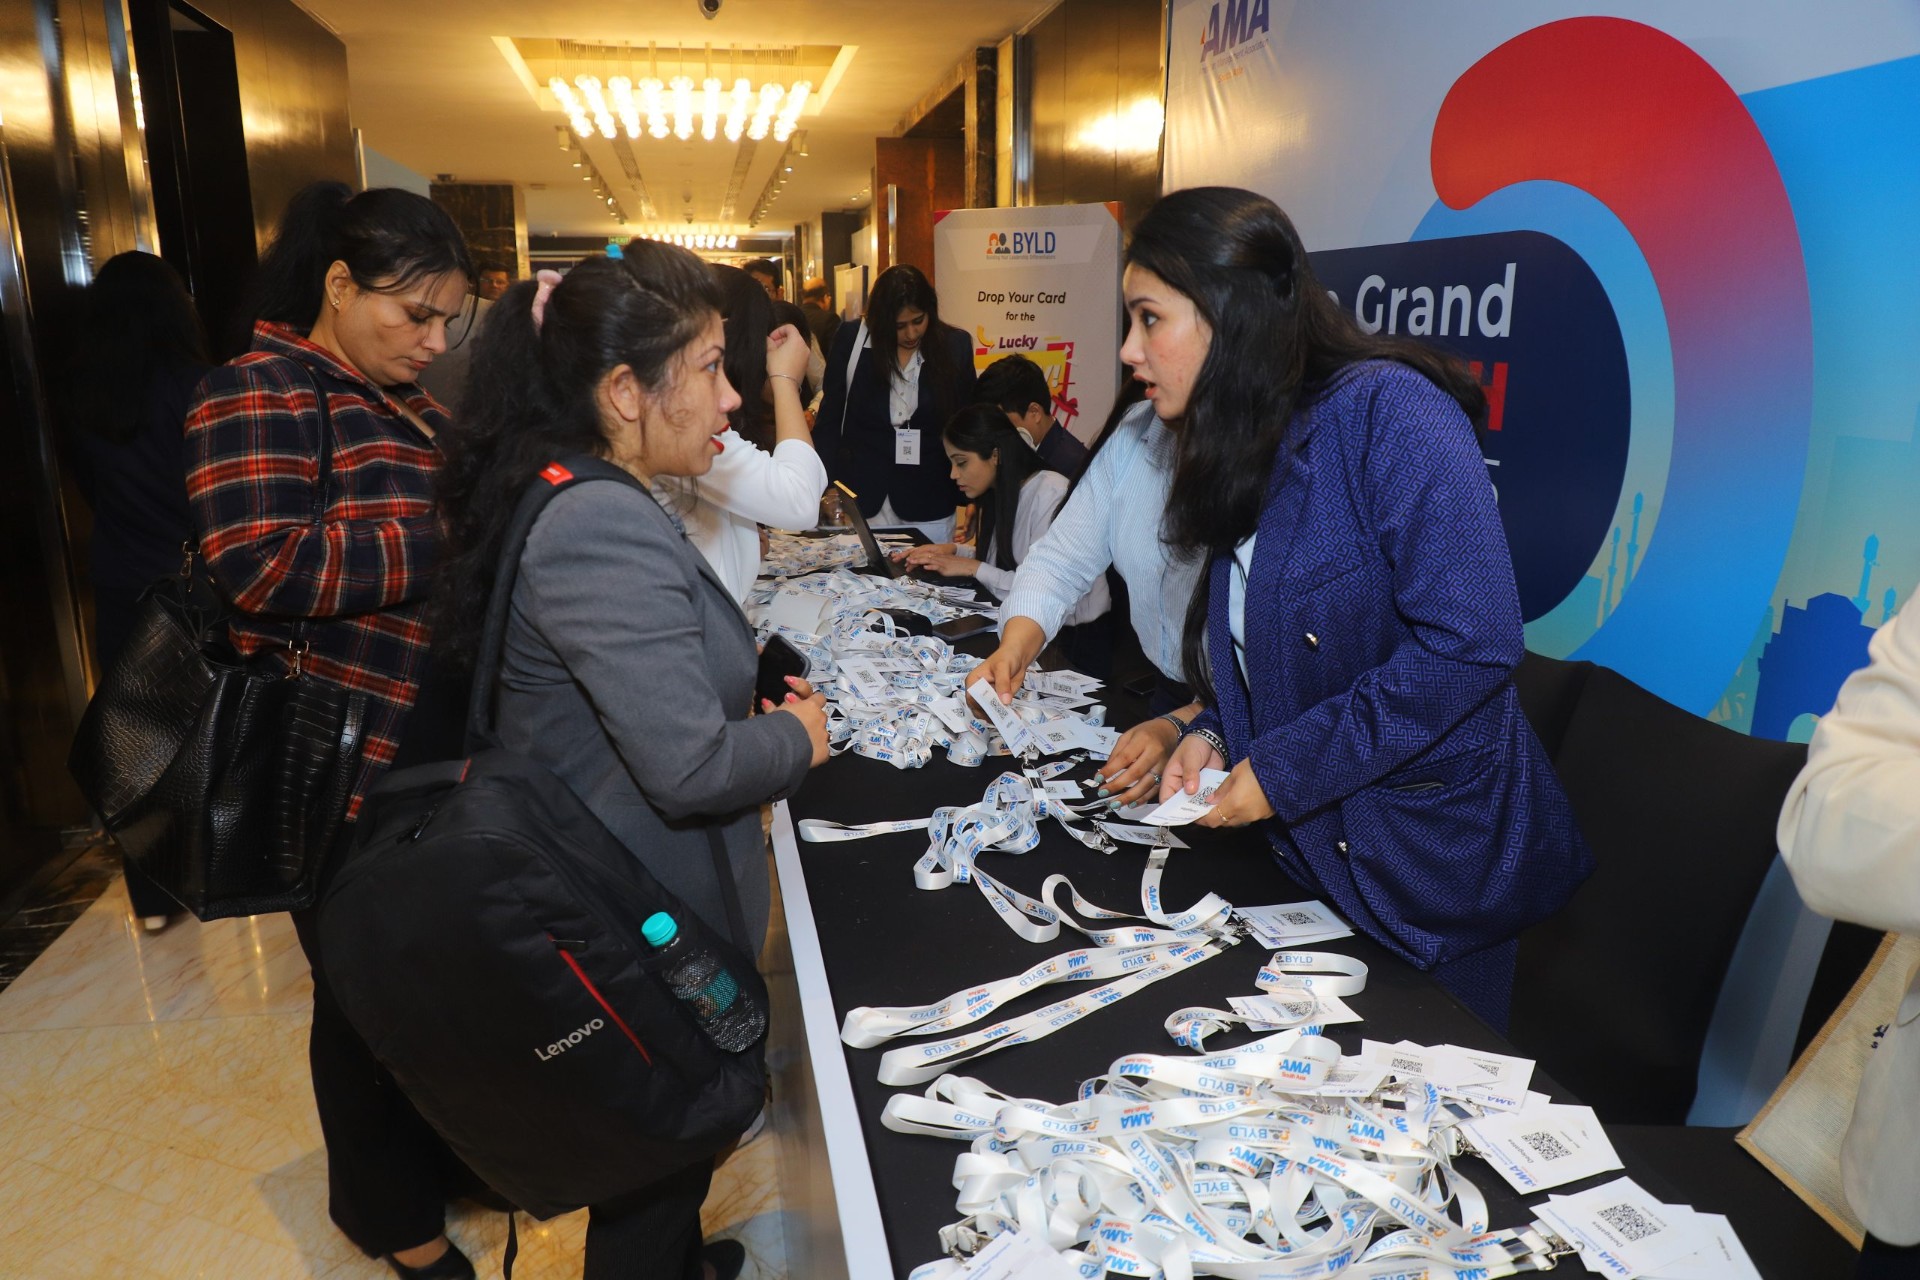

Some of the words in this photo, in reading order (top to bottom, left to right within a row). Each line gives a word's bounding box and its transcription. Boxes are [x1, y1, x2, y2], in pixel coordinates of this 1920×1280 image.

[1200, 0, 1269, 62] AMA
[1013, 231, 1056, 254] BYLD
[977, 291, 1005, 305] Drop
[1008, 291, 1034, 303] Your
[1037, 292, 1067, 304] Card
[1355, 262, 1517, 338] Grand
[1006, 311, 1018, 321] for
[1020, 312, 1036, 321] the
[998, 335, 1039, 350] Lucky
[1149, 885, 1159, 911] AMA
[1038, 908, 1057, 921] BYLD
[1172, 914, 1196, 929] BYLD
[1134, 933, 1155, 942] AMA
[1068, 955, 1088, 968] AMA
[1122, 957, 1143, 968] BYLD
[1182, 951, 1205, 963] AMA
[1020, 969, 1044, 986] BYLD
[1100, 992, 1123, 1004] AMA
[910, 1009, 937, 1019] BYLD
[968, 1000, 994, 1018] AMA
[1186, 1012, 1215, 1020] BYLD
[534, 1017, 604, 1062] Lenovo
[984, 1026, 1010, 1039] AMA
[924, 1044, 952, 1057] BYLD
[1120, 1064, 1155, 1074] AMA
[1280, 1059, 1311, 1075] AMA
[1198, 1077, 1235, 1093] BYLD
[1199, 1102, 1235, 1113] BYLD
[954, 1113, 986, 1126] BYLD
[1042, 1120, 1078, 1132] BYLD
[1120, 1112, 1155, 1129] AMA
[1229, 1126, 1268, 1138] BYLD
[1348, 1123, 1385, 1141] AMA
[1052, 1143, 1085, 1154] BYLD
[1131, 1140, 1159, 1172] BYLD
[1229, 1146, 1264, 1168] AMA
[1308, 1156, 1346, 1177] AMA
[1390, 1197, 1427, 1226] BYLD
[1185, 1212, 1217, 1244] AMA
[1100, 1229, 1133, 1243] AMA
[1105, 1255, 1139, 1272] AMA
[1328, 1250, 1353, 1272] AMA
[1599, 1251, 1630, 1275] AMA
